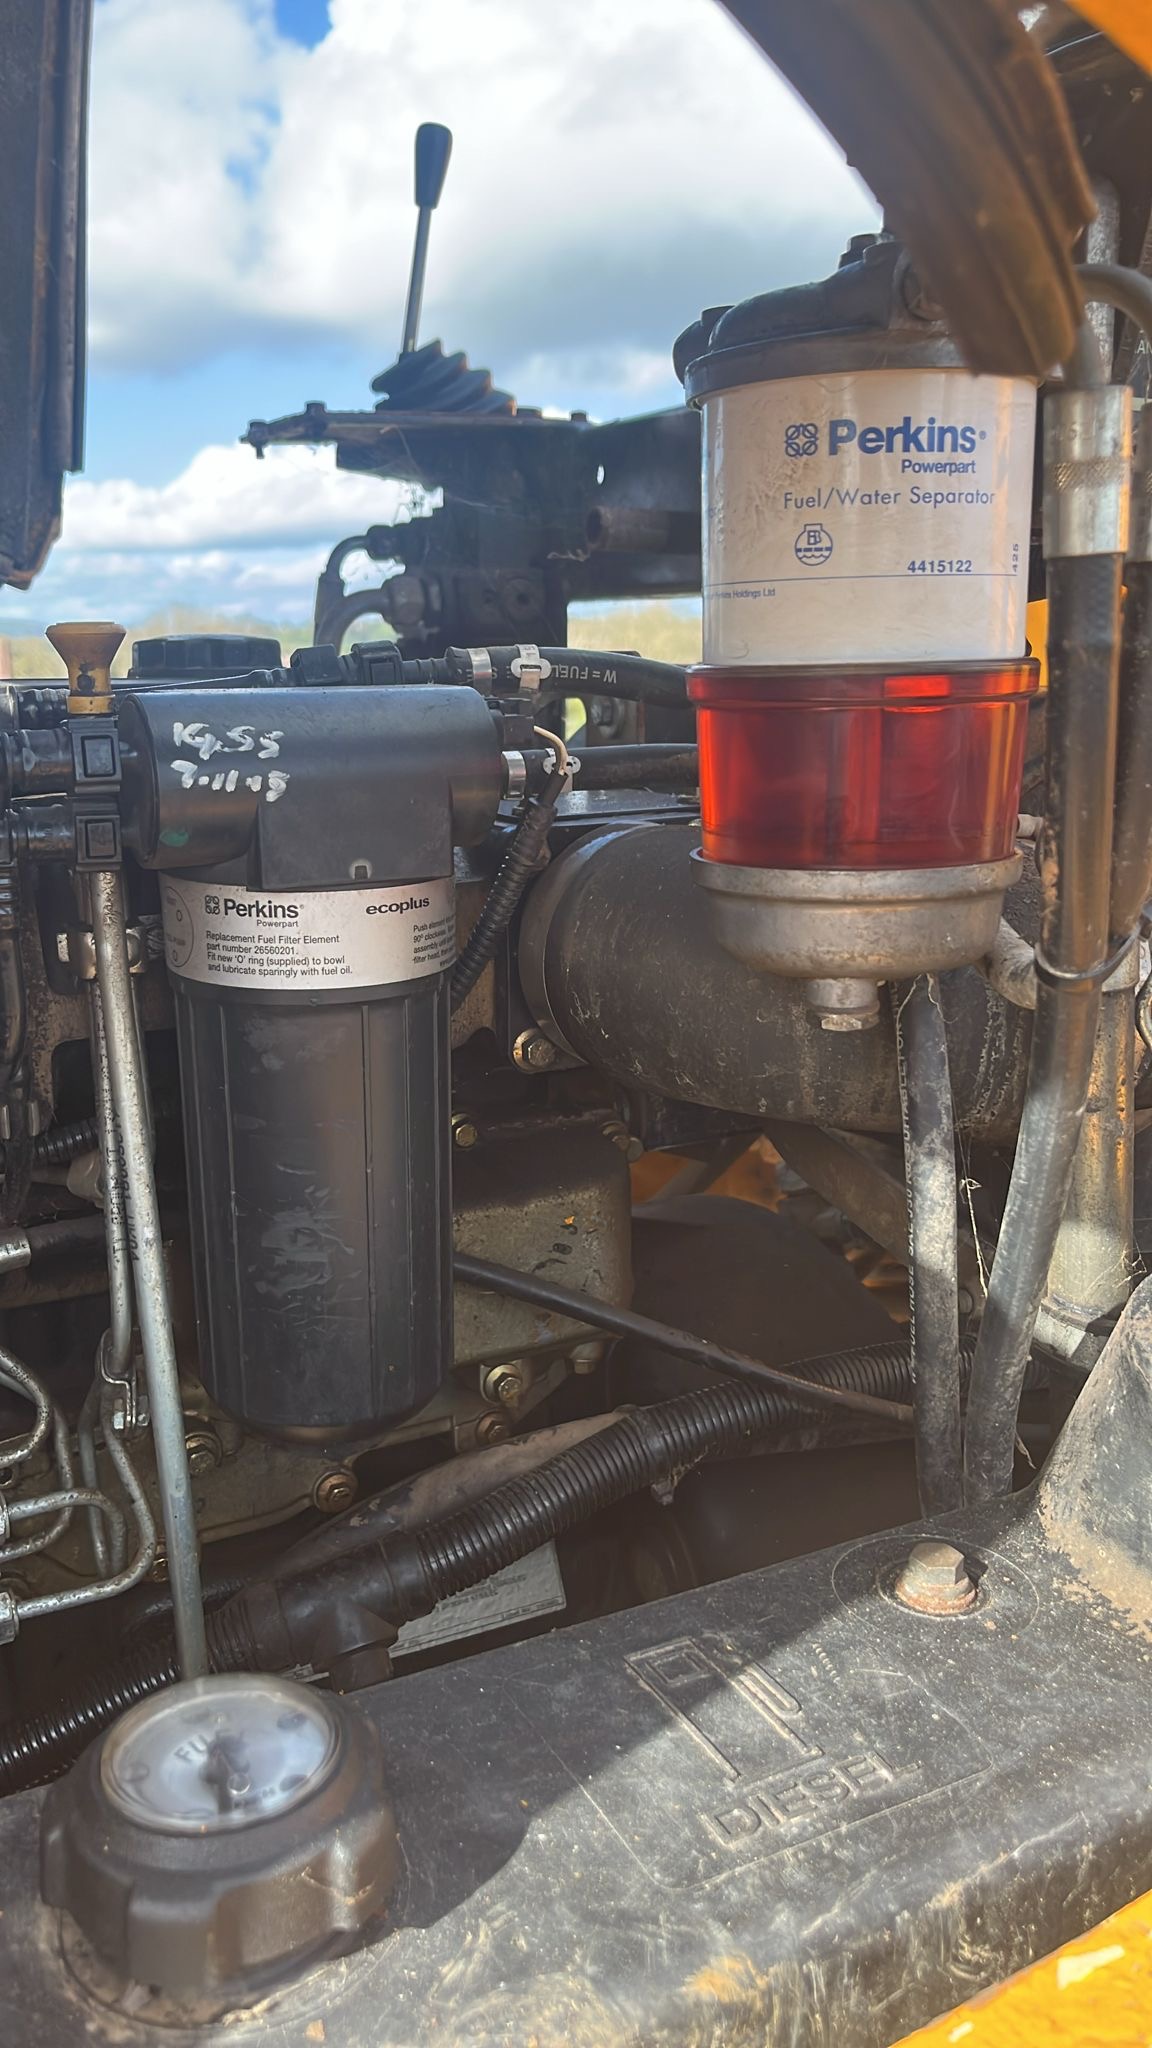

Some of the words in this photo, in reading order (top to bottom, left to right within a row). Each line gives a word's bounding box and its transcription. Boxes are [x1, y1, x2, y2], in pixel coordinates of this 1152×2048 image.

[901, 459, 976, 476] Powerpart
[784, 487, 901, 509] Fuel/Water
[909, 486, 995, 508] Separator
[907, 560, 972, 573] 4415122
[763, 588, 776, 597] Ltd
[551, 664, 590, 680] FUEL
[603, 670, 617, 684] W
[366, 897, 430, 914] ecoplus
[257, 919, 299, 928] Powerpart
[413, 924, 428, 933] Push
[206, 930, 255, 943] Replacement
[257, 935, 276, 943] Fuel
[278, 935, 301, 944] Filter
[303, 934, 340, 944] Element
[206, 942, 220, 951] part
[222, 944, 252, 954] number
[254, 946, 298, 955] 26560201.
[207, 952, 217, 961] Fit
[217, 954, 232, 962] new
[248, 956, 264, 966] ring
[266, 956, 310, 967] (supplied)
[312, 957, 321, 965] to
[323, 955, 345, 965] bowl
[208, 963, 220, 972] and
[222, 964, 256, 975] lubricate
[258, 967, 298, 978] sparingly
[300, 967, 319, 976] with
[321, 966, 338, 975] fuel
[700, 1751, 922, 1848] DIESEL
